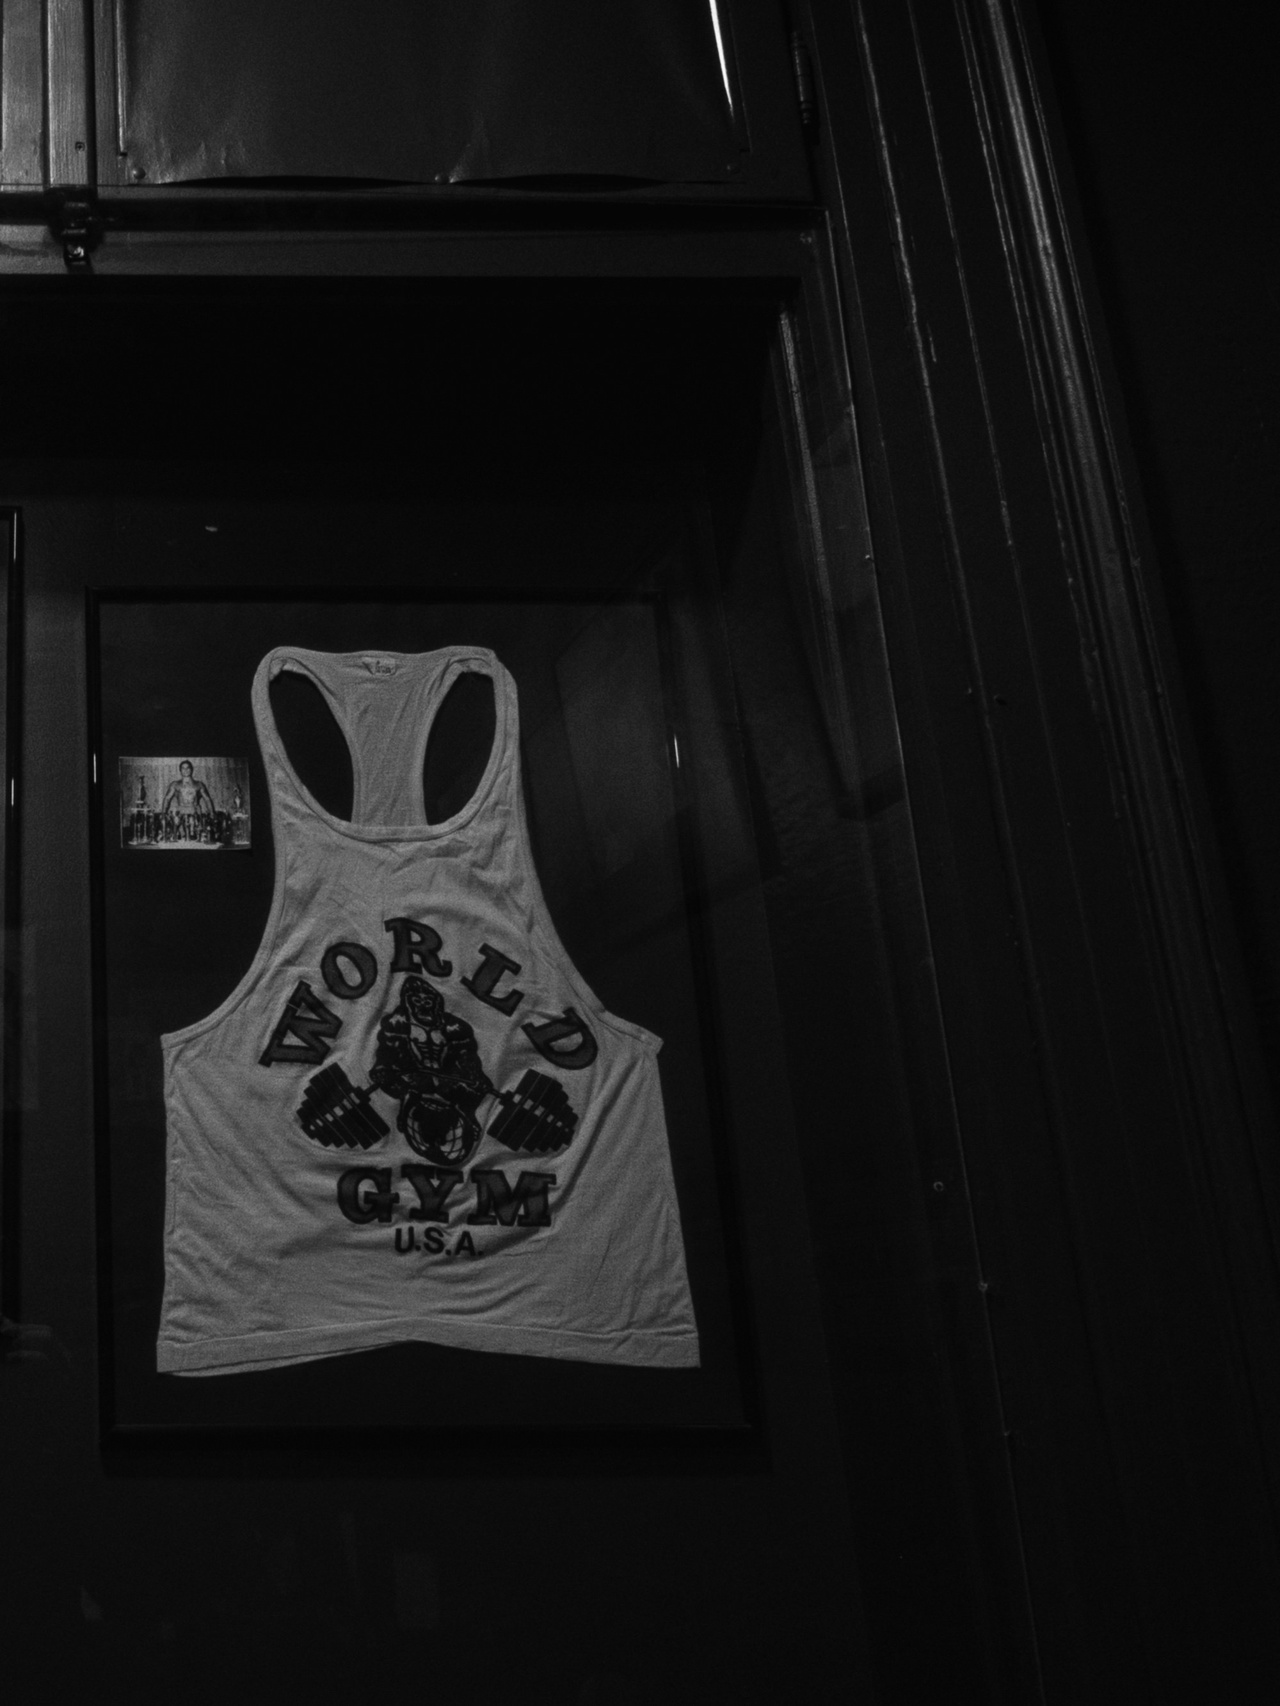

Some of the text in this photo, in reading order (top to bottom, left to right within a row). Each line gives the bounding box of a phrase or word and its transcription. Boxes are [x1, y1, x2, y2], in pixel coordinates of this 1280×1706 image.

[258, 917, 598, 1070] WORLD
[337, 1165, 557, 1227] GYM
[394, 1226, 483, 1256] U.S.A.
